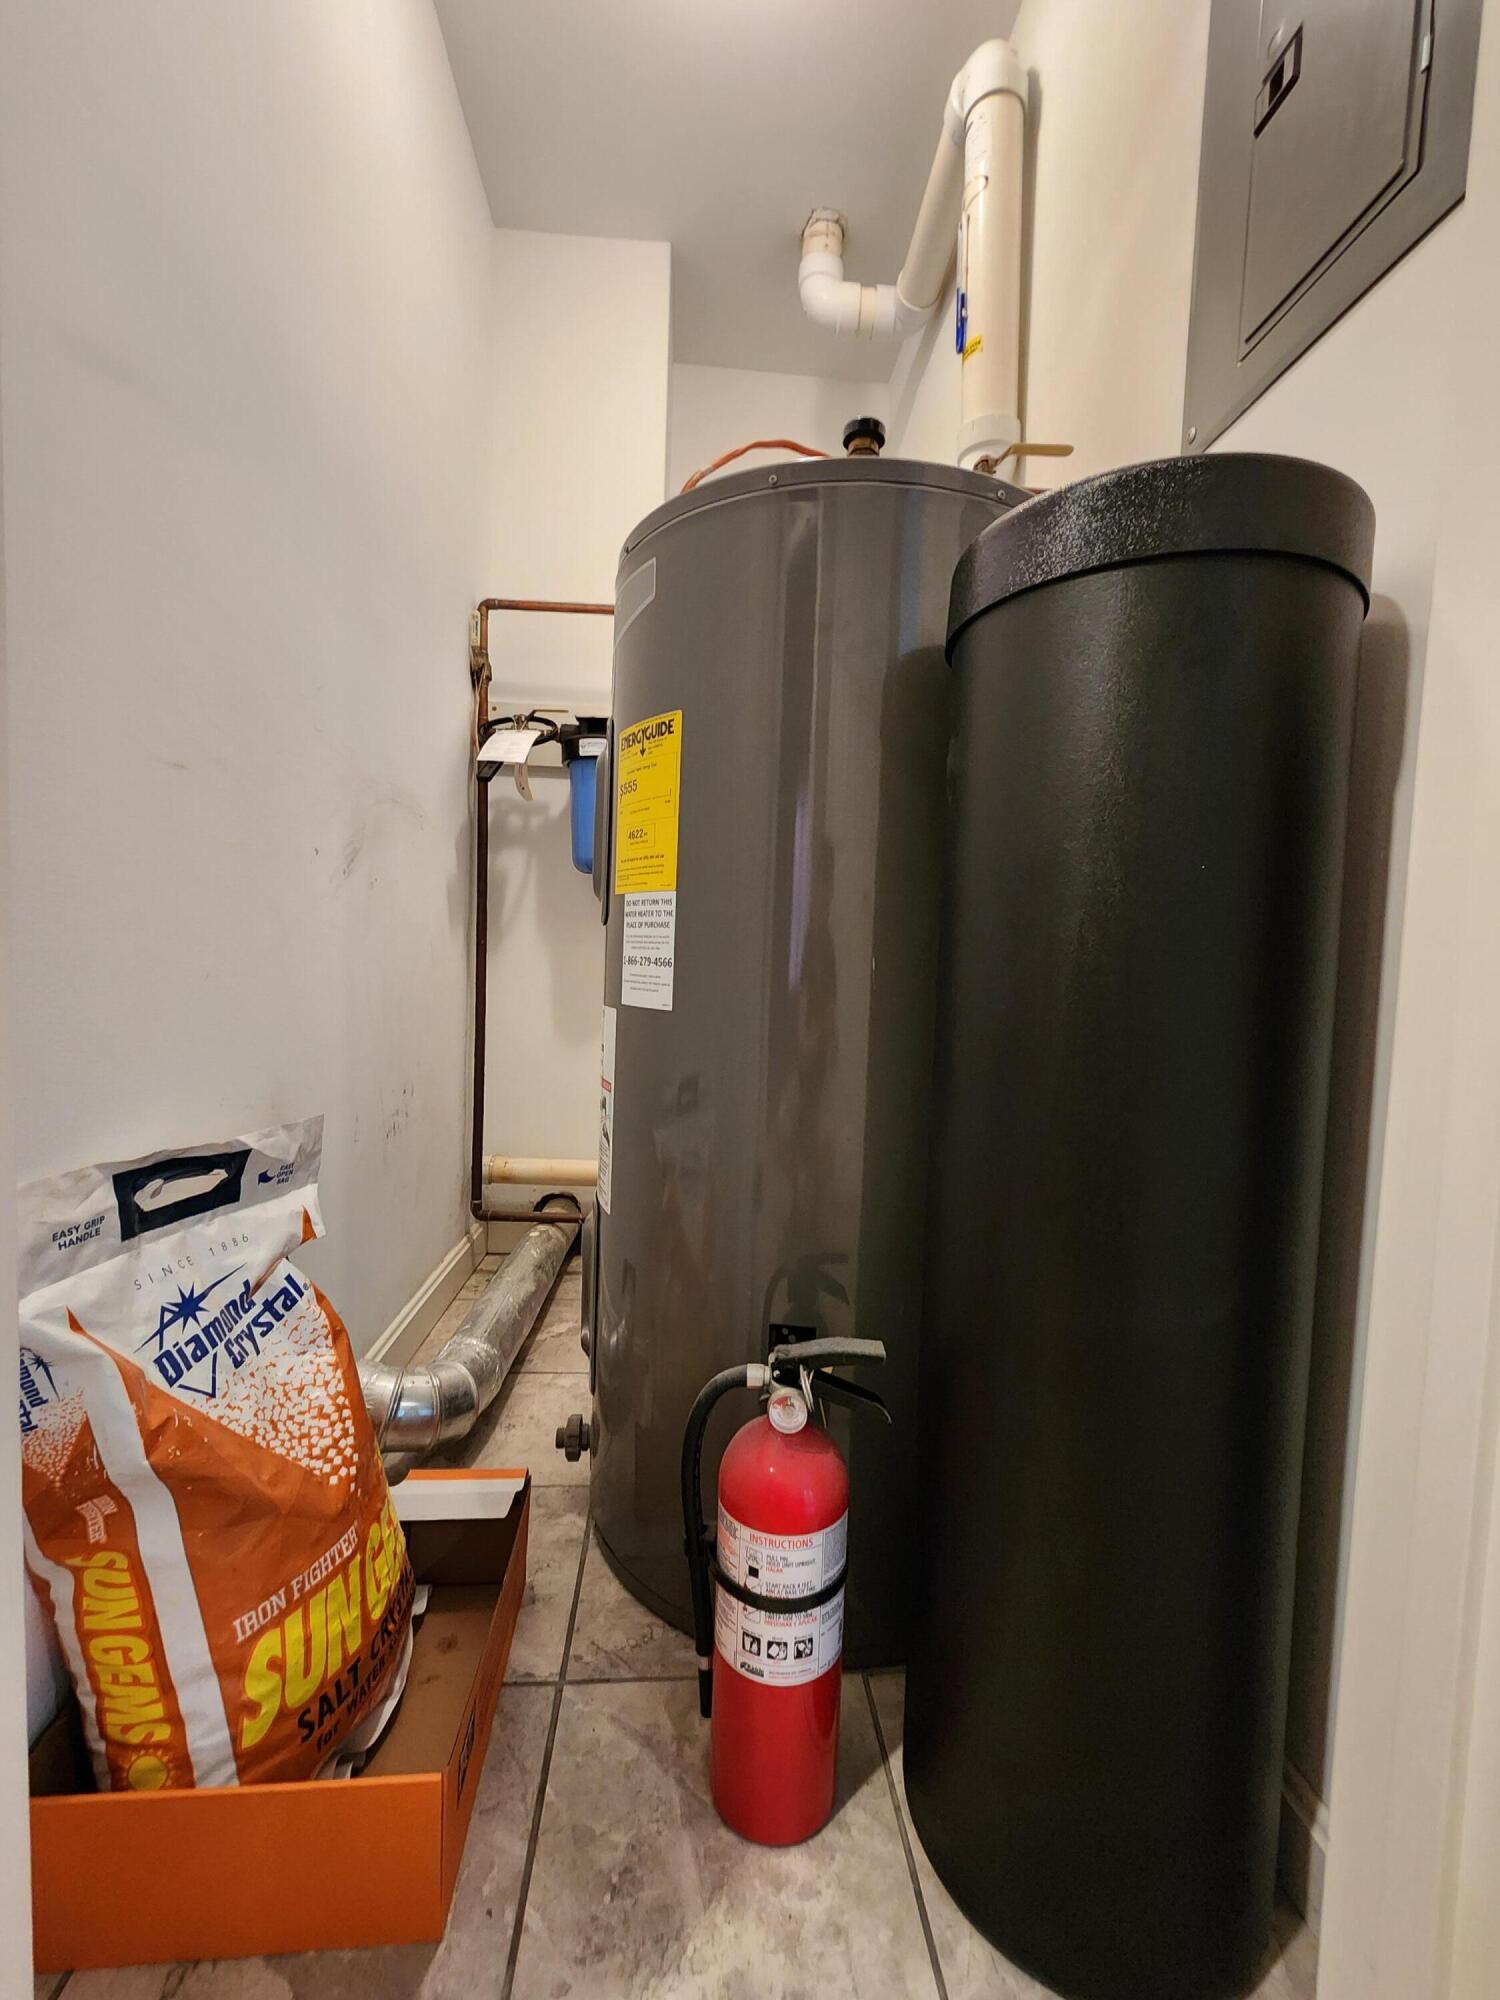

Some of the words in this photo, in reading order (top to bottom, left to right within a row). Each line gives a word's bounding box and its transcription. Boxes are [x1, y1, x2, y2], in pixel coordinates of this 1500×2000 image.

[641, 898, 660, 906] RETURN
[661, 898, 672, 906] THIS
[624, 956, 672, 968] 1-866-279-4566
[52, 1224, 80, 1242] EASY
[84, 1215, 105, 1230] GRIP
[58, 1228, 101, 1251] HANDLE
[134, 1256, 194, 1290] SINCE
[209, 1233, 249, 1256] 1886
[153, 1279, 256, 1388] Diamond
[224, 1273, 304, 1369] Crystal
[750, 1534, 814, 1549] INSTRUCTIONS
[64, 1551, 142, 1630] SUN
[232, 1587, 287, 1643] IRON
[289, 1523, 358, 1600] FIGHTER
[242, 1554, 362, 1749] SUN
[89, 1635, 171, 1744] GEMS
[298, 1656, 361, 1743] SALT
[317, 1719, 340, 1751] for
